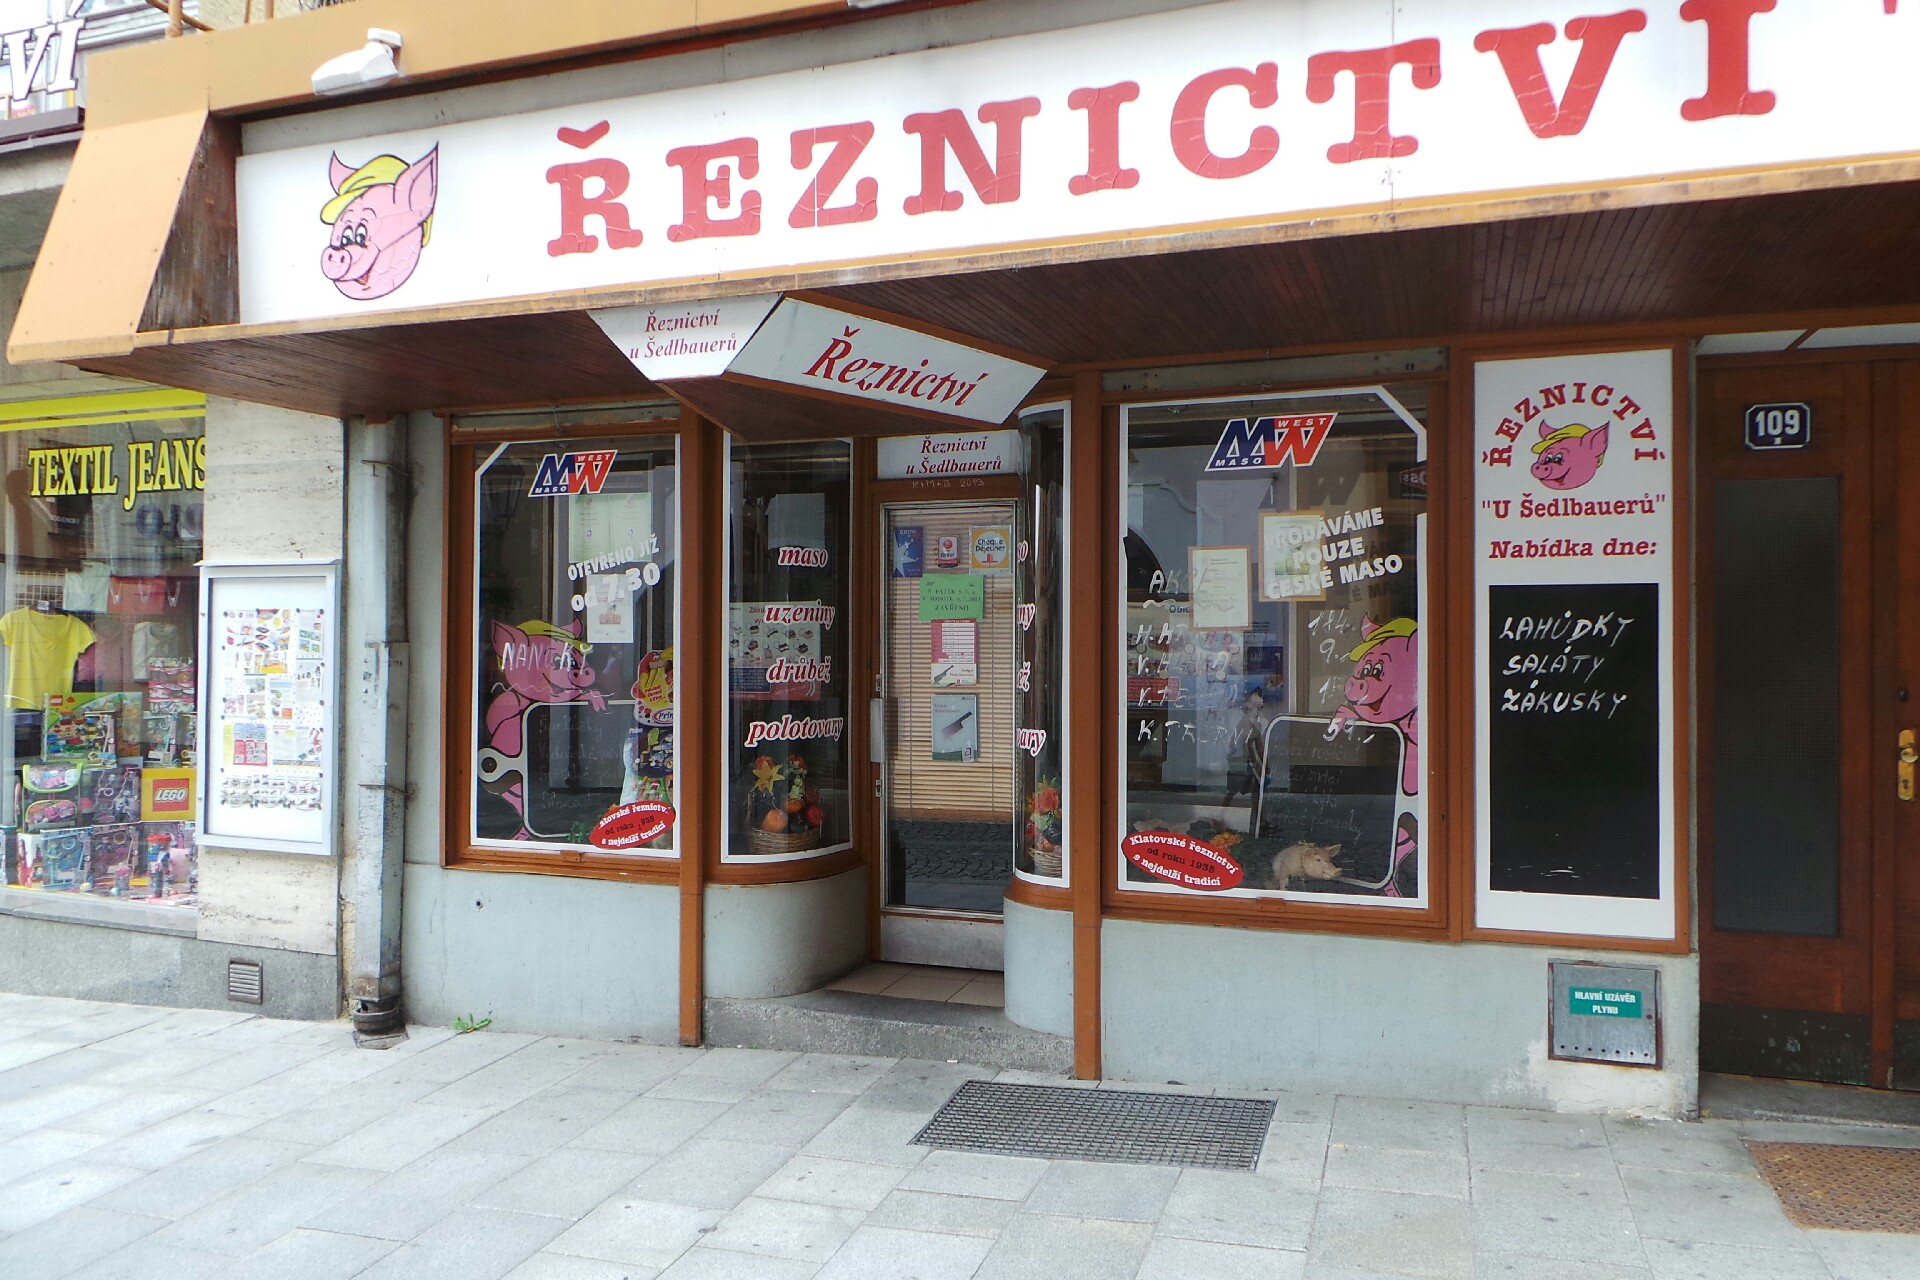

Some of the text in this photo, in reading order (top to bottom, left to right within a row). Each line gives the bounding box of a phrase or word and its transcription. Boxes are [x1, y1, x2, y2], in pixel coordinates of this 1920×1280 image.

[0, 0, 86, 102] VÍ
[644, 308, 720, 333] Řeznictví
[629, 332, 738, 359] u Šedlbauerů
[802, 325, 989, 406] Řeznictví
[1278, 417, 1327, 428] WEST
[1482, 382, 1666, 467] ŘEZNICTVÍ
[1755, 409, 1800, 437] 109
[577, 454, 611, 462] WEST
[920, 435, 988, 454] Řeznictví
[28, 435, 207, 511] TEXTIL JEANS
[905, 455, 1002, 475] u Šedlbauerů
[1215, 457, 1262, 467] MASO
[534, 485, 567, 493] MASO
[567, 532, 660, 581] OTEVŘENO JIŽ
[778, 546, 828, 567] maso
[1292, 536, 1366, 570] POUZE
[1488, 537, 1657, 559] Nabídka dne:
[602, 562, 660, 603] 7.30
[1267, 566, 1334, 599] ČESKÉ
[1339, 554, 1403, 584] MASO
[765, 599, 835, 630] uzeniny
[766, 655, 832, 684] drůbež
[1502, 645, 1605, 683] SALÁTY
[744, 714, 843, 747] polotovary
[155, 788, 188, 802] LEGO
[599, 803, 669, 830] atovské řeznictv
[607, 832, 640, 848] nejdelší
[1129, 834, 1239, 875] Klatovské řeznictví
[1147, 847, 1159, 857] od
[1162, 852, 1186, 865] roku
[1133, 853, 1222, 887] s nejdelší tradicí
[1574, 991, 1636, 1004] HLAVNÍ UZÁVĚR
[1592, 1004, 1619, 1015] PLYNU
